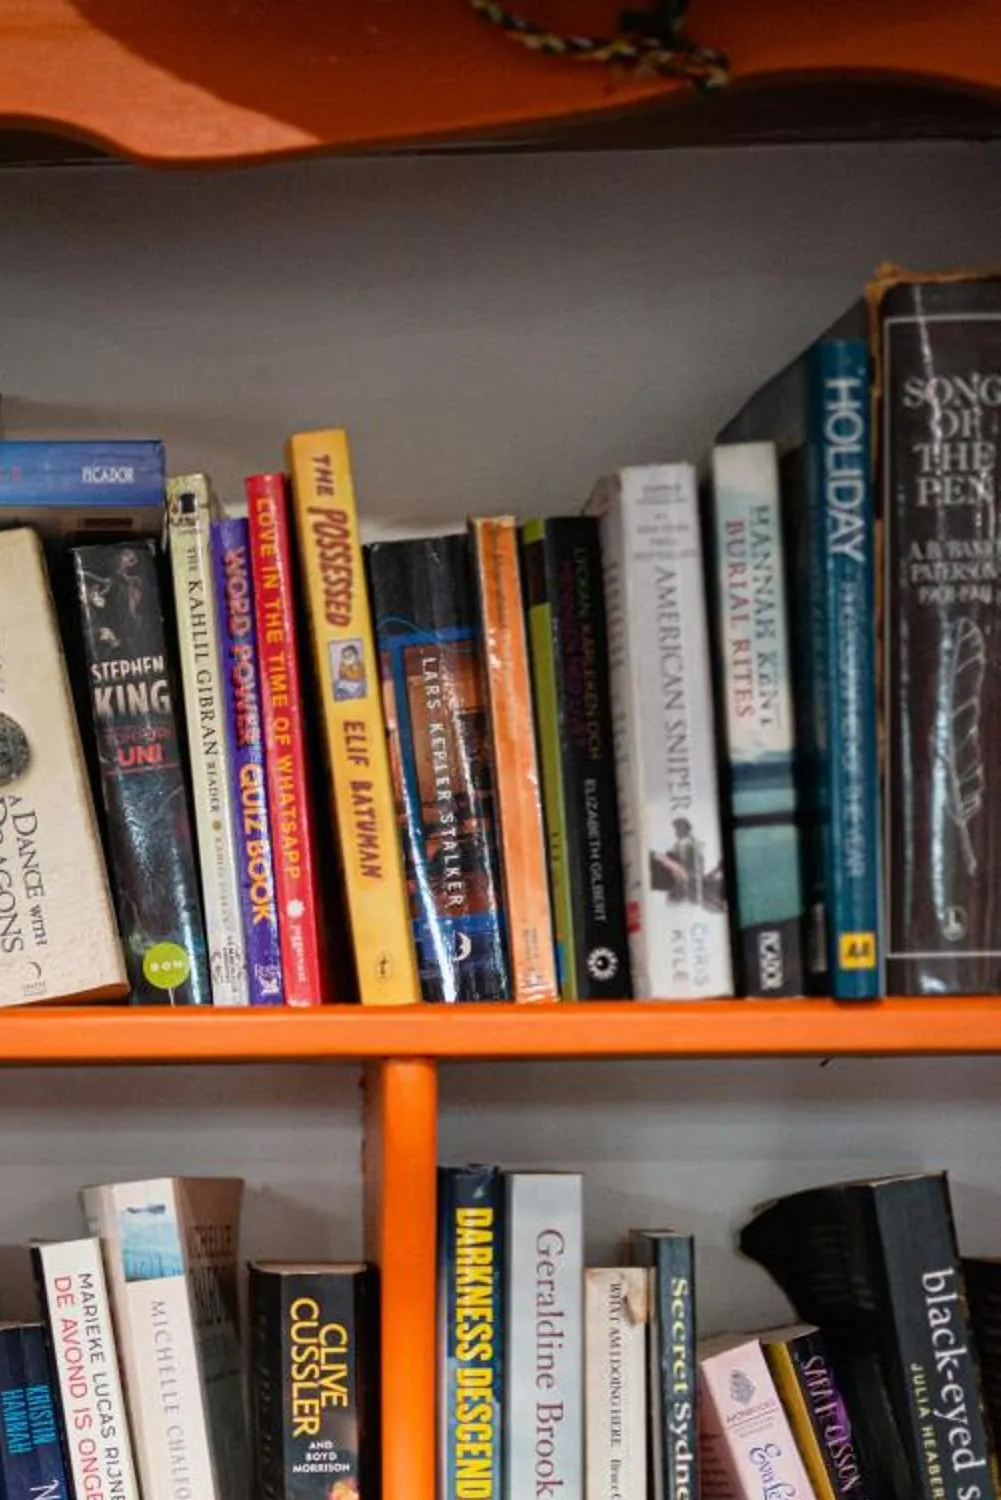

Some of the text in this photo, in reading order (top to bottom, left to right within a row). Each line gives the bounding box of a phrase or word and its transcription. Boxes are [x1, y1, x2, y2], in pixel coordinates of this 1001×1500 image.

[903, 372, 1001, 410] SONG
[824, 377, 866, 563] HOLIDAY
[913, 442, 996, 473] THE
[917, 476, 996, 507] PEN
[307, 454, 353, 627] THE POSSESSED
[751, 505, 777, 639] HANNAH
[90, 656, 165, 682] STEPHEN
[188, 580, 219, 755] KAHLIL GIBRAN
[655, 565, 686, 711] AMERICAN
[726, 519, 756, 719] BURIAL RITES
[94, 680, 171, 716] KING
[257, 497, 300, 879] LOVE IN THE TIME OF WHATSAPP
[343, 719, 382, 879] ELIF BATUMAN
[422, 656, 464, 906] LARS KEPLER STALKER
[665, 721, 693, 811] SNIPER
[12, 810, 45, 898] DANCE
[239, 763, 274, 924] QUIZ BOOK
[54, 1276, 75, 1308] DE
[455, 1207, 494, 1361] DARKNESS
[535, 1229, 566, 1389] Geraldine
[670, 1278, 689, 1395] Secret
[61, 1318, 88, 1397] AVOND
[78, 1273, 106, 1364] MARIEKE
[92, 1373, 116, 1439] LUCAS
[151, 1300, 180, 1415] MICHELLE
[290, 1297, 321, 1438] CUSSLER
[319, 1323, 347, 1408] CLIVE
[910, 1363, 932, 1418] JULIA
[921, 1268, 987, 1472] black-eyed
[2, 1389, 33, 1455] HANNAH
[25, 1385, 56, 1446] KRISTIN
[74, 1408, 93, 1430] IS
[293, 1463, 350, 1473] MORRISON
[308, 1440, 334, 1449] AND
